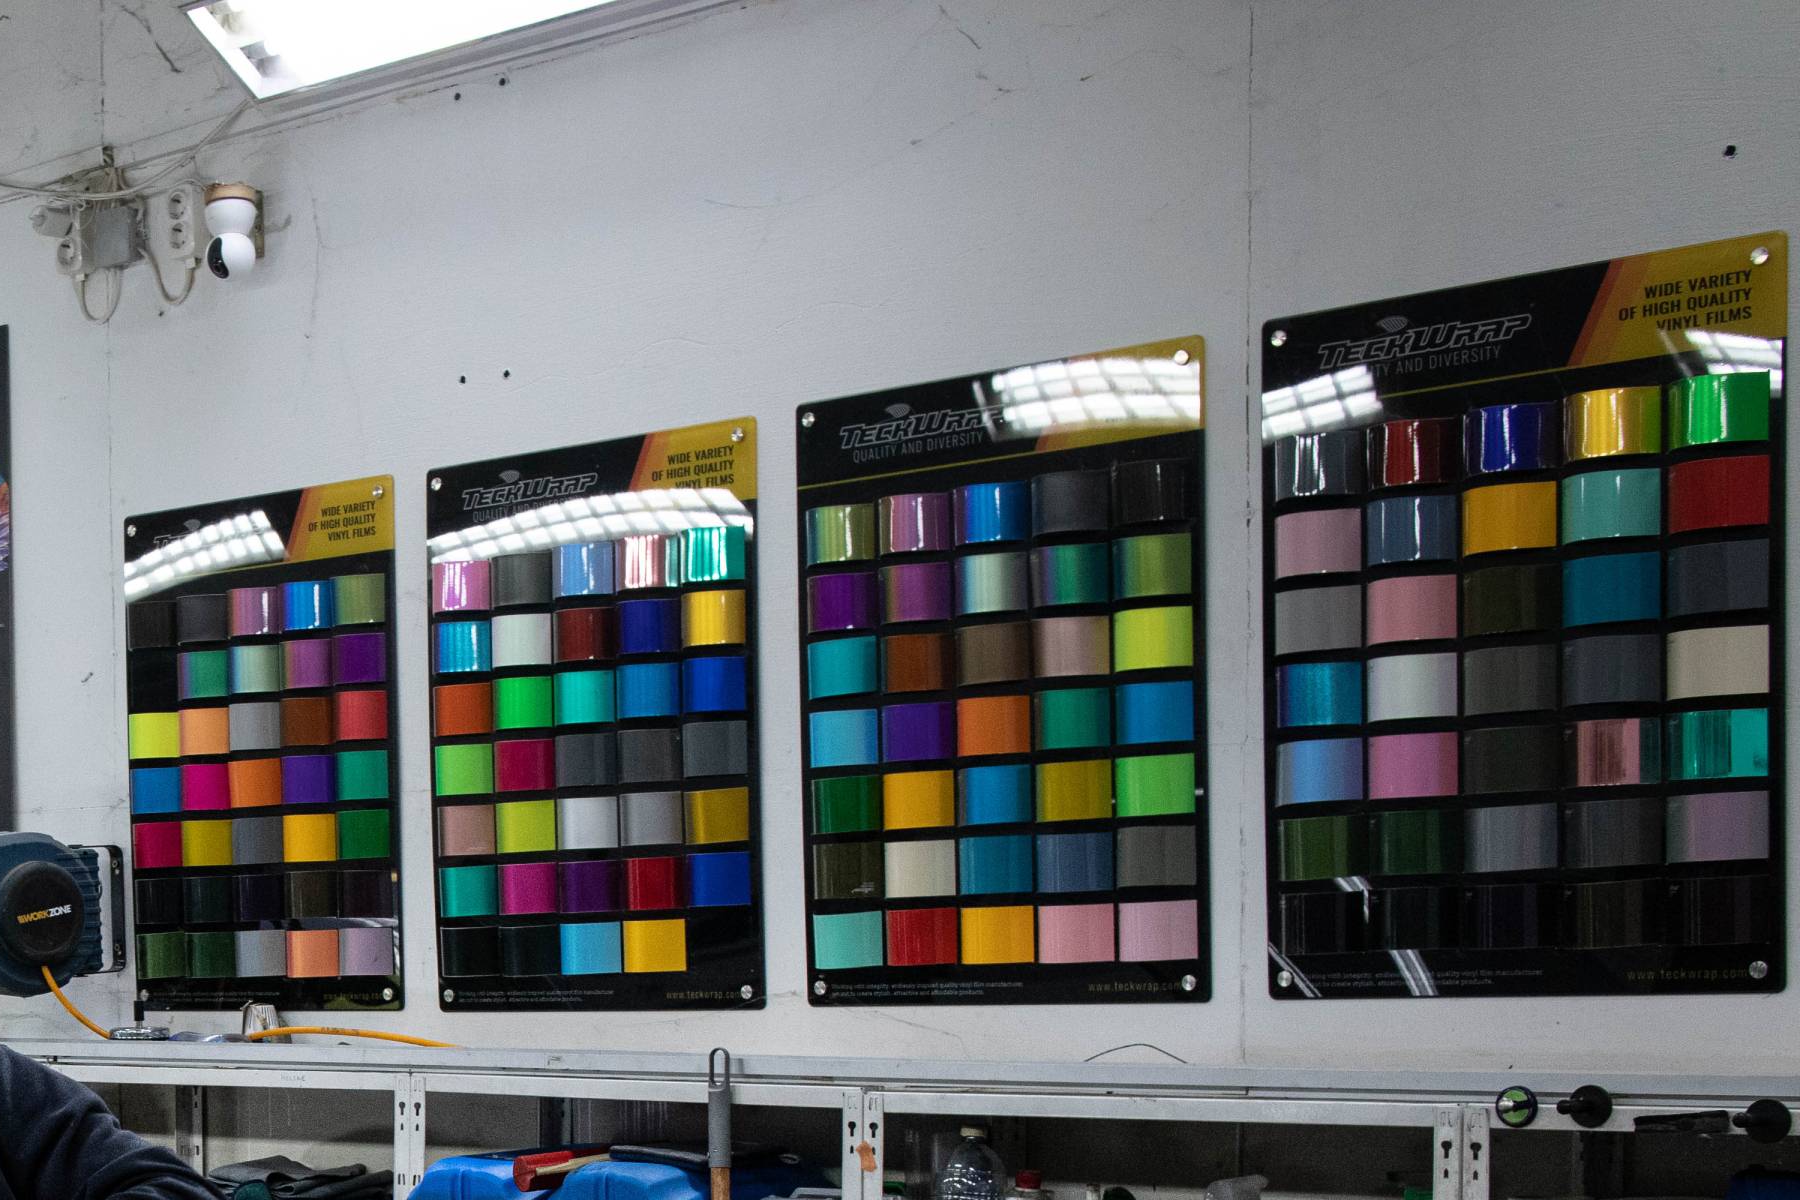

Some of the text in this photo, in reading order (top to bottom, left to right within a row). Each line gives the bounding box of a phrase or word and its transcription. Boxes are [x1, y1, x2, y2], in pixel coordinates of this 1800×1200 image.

[1644, 269, 1752, 299] WIDE VARIETY
[1618, 287, 1752, 321] OF HIGH QUALITY
[1656, 306, 1752, 332] VINYL FILMS
[1396, 357, 1423, 375] AND
[1429, 345, 1501, 370] DIVERSITY
[667, 445, 734, 466] WIDE VARIETY
[853, 431, 983, 464] QUALITY AND DIVERSITY
[651, 460, 734, 482] OF HIGH QUALITY
[705, 473, 734, 488] FILMS
[321, 500, 376, 518] WIDE VARIETY
[308, 513, 376, 532] OF HIGH QUALITY
[328, 526, 376, 542] VINYL FILMS
